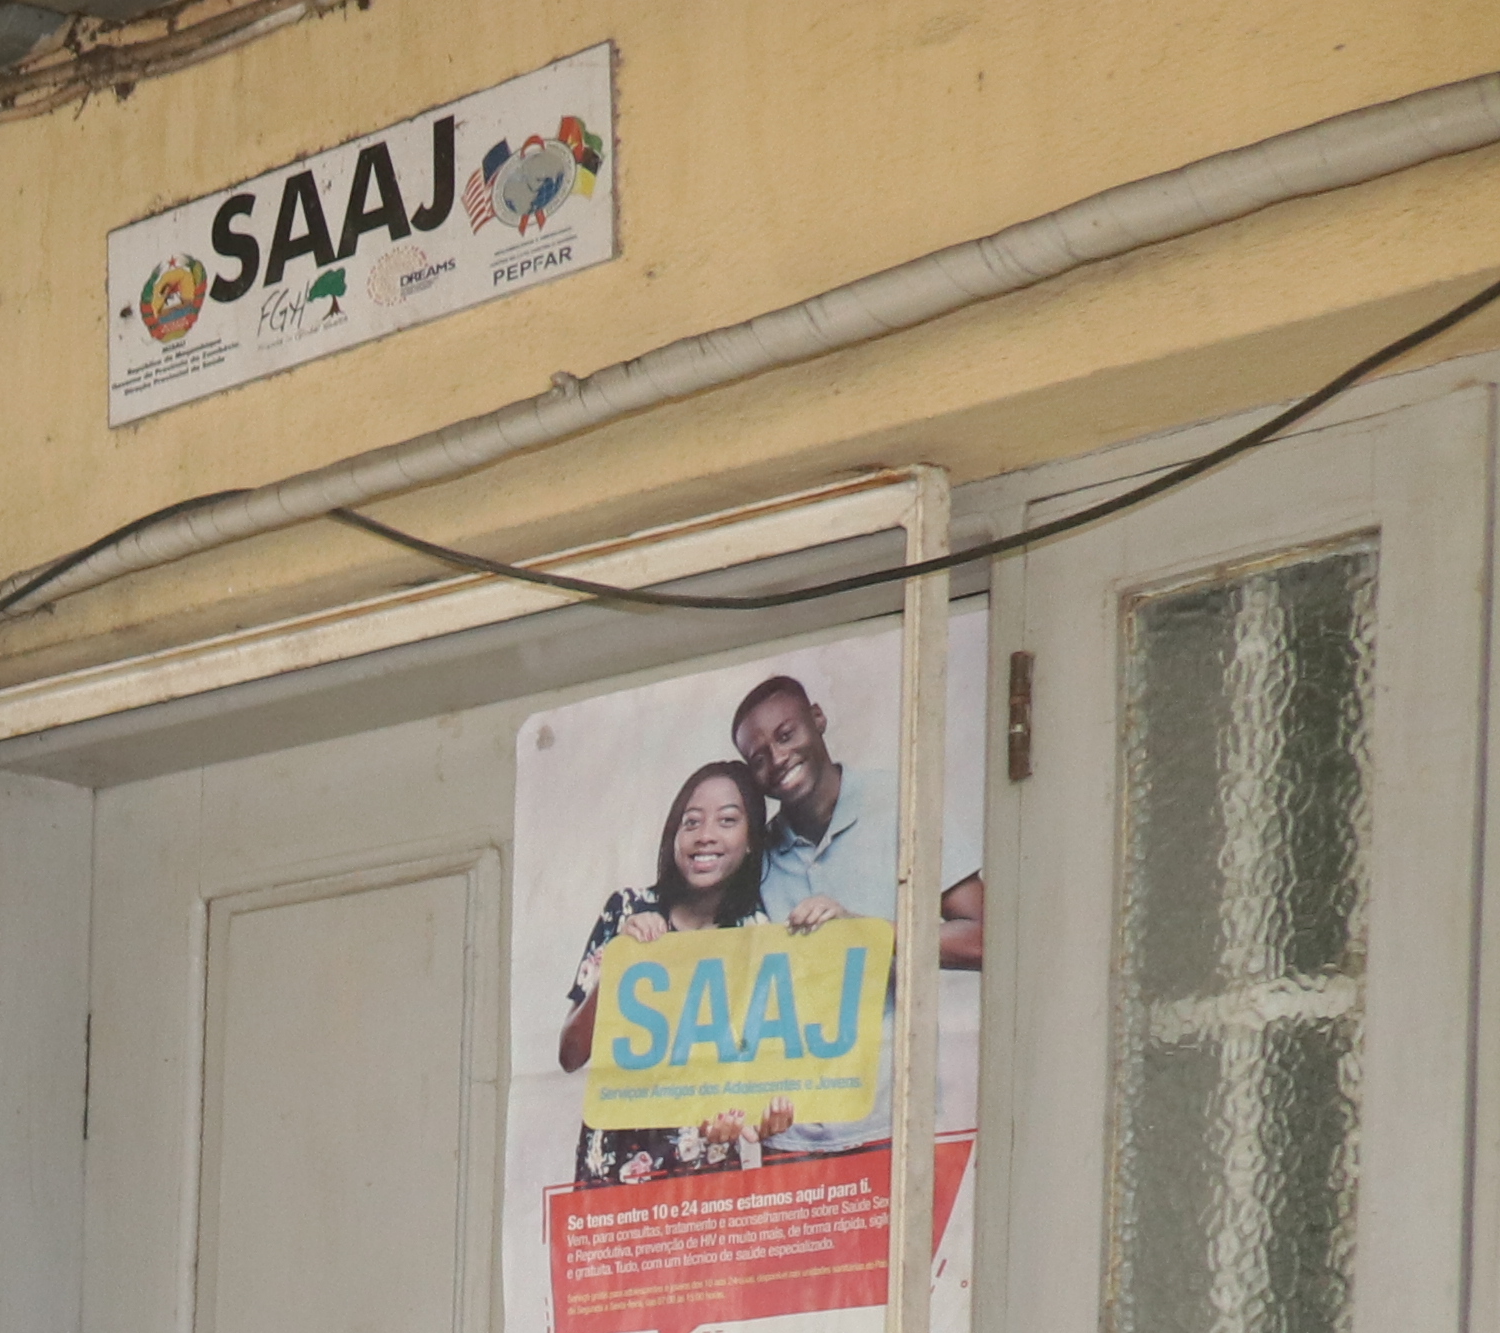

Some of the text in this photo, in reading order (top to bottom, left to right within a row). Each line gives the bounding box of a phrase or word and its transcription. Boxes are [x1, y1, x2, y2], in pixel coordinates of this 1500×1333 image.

[208, 114, 456, 302] SAAJ
[400, 257, 456, 288] DREAMS
[493, 246, 572, 287] PEPFAR
[612, 947, 867, 1071] SAAJ
[567, 1233, 591, 1247] Vem,
[592, 1232, 615, 1246] para
[616, 1225, 664, 1241] consultas,
[665, 1217, 717, 1235] tratamento
[719, 1218, 726, 1228] e
[728, 1207, 810, 1228] aconselhamento
[811, 1204, 839, 1218] sobre
[841, 1198, 871, 1215] Saúde
[568, 1177, 872, 1231] Se tens entre 10 e 24 anos estamos aqui para ti.
[567, 1253, 574, 1263] e
[575, 1246, 633, 1262] Reprodutiva,
[635, 1238, 684, 1258] prevenção
[686, 1237, 699, 1249] de
[700, 1233, 718, 1247] HIV
[719, 1234, 726, 1245] e
[728, 1230, 757, 1245] muito
[759, 1226, 786, 1242] mais,
[787, 1225, 801, 1238] de
[803, 1222, 831, 1235] forma
[833, 1217, 867, 1233] rápida,
[567, 1268, 573, 1279] e
[615, 1260, 640, 1273] Tudo,
[641, 1258, 662, 1271] com
[664, 1256, 681, 1268] um
[683, 1251, 718, 1266] técnico
[719, 1248, 733, 1262] de
[735, 1246, 766, 1261] saúde
